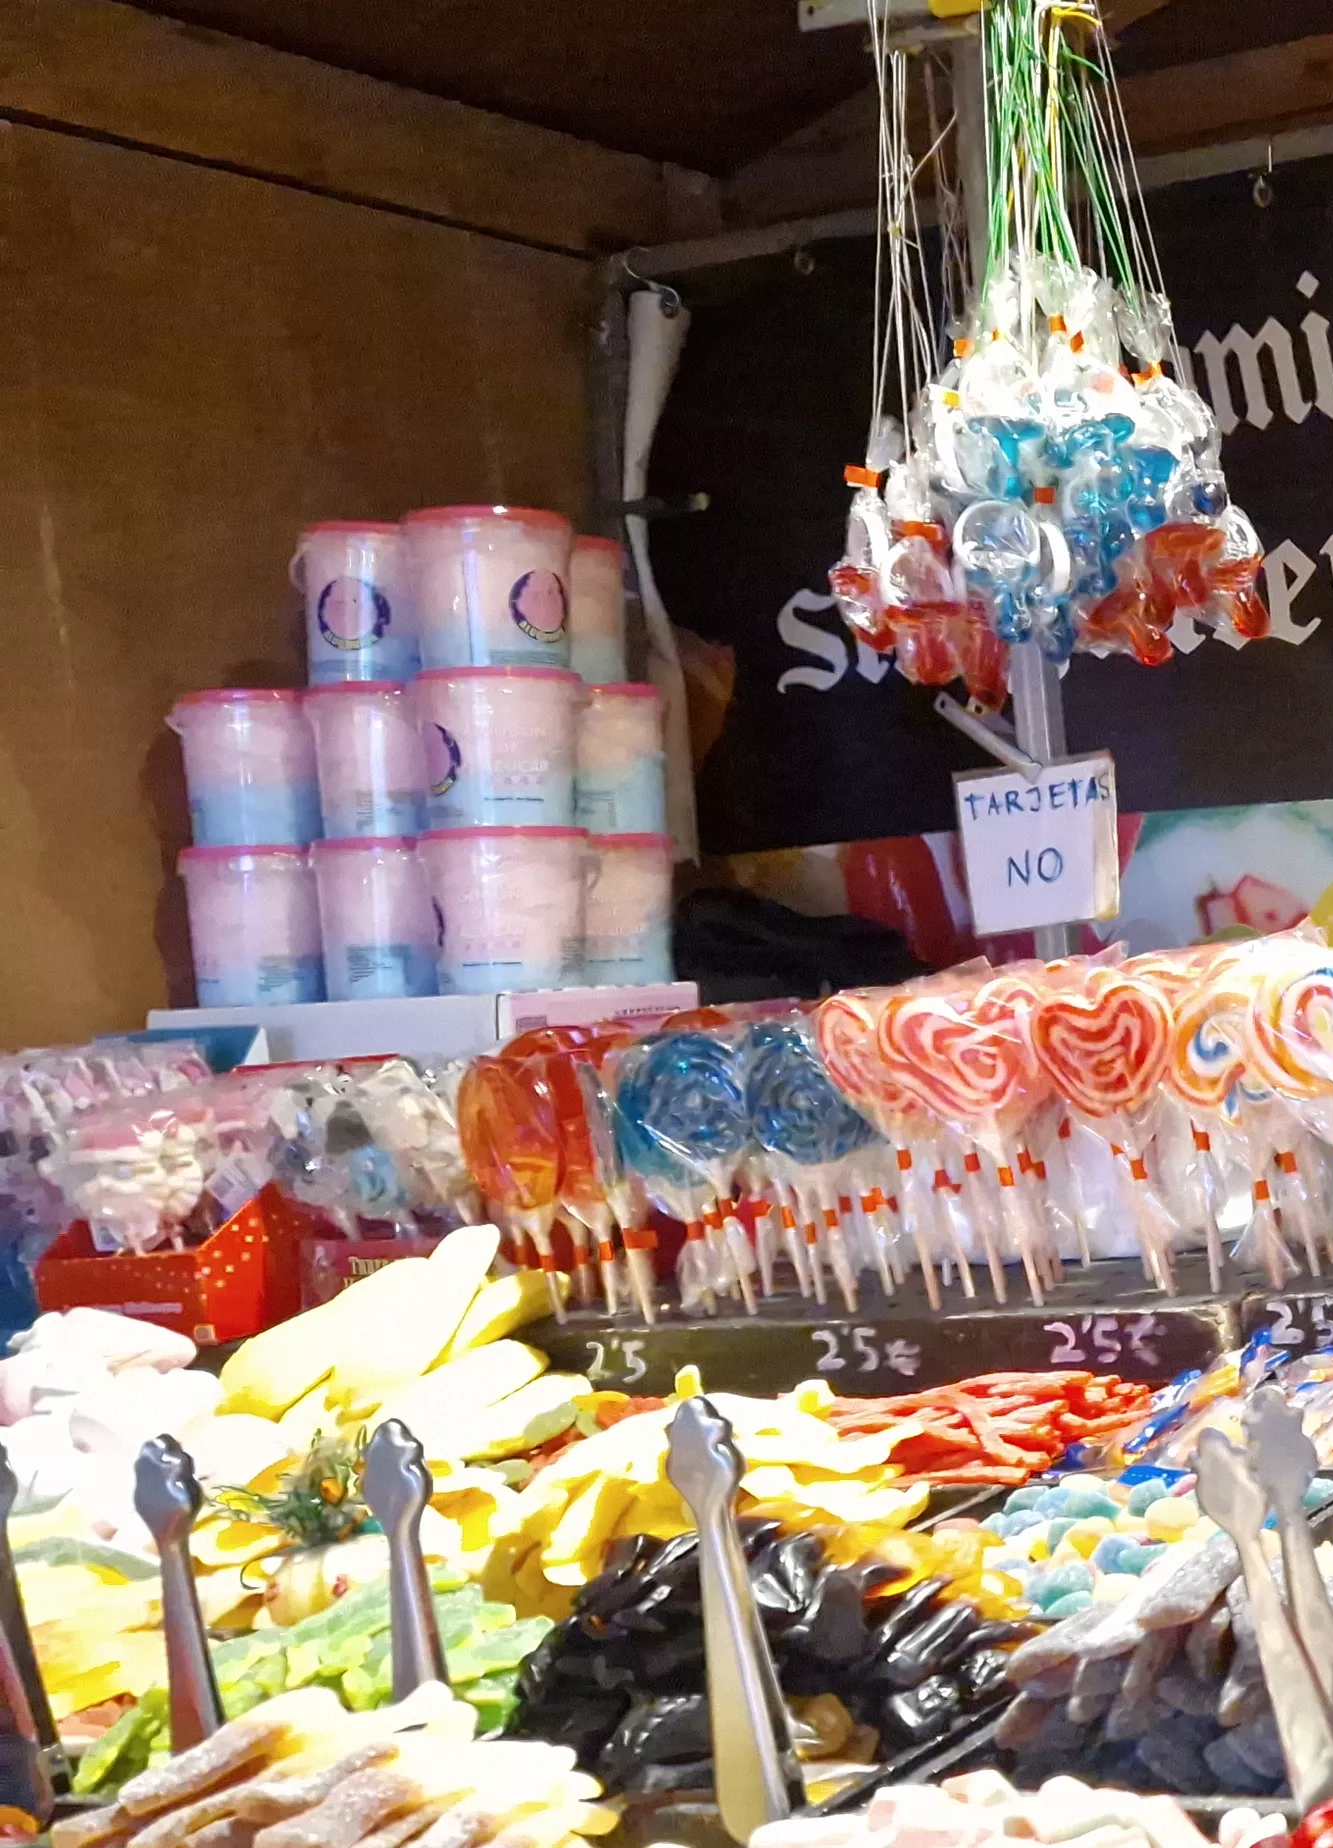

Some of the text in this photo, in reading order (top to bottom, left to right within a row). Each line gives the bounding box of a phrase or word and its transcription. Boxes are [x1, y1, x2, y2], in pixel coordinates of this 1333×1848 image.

[964, 771, 1110, 820] TARJETAS
[1007, 847, 1064, 887] NO
[585, 1334, 648, 1385] 2'5
